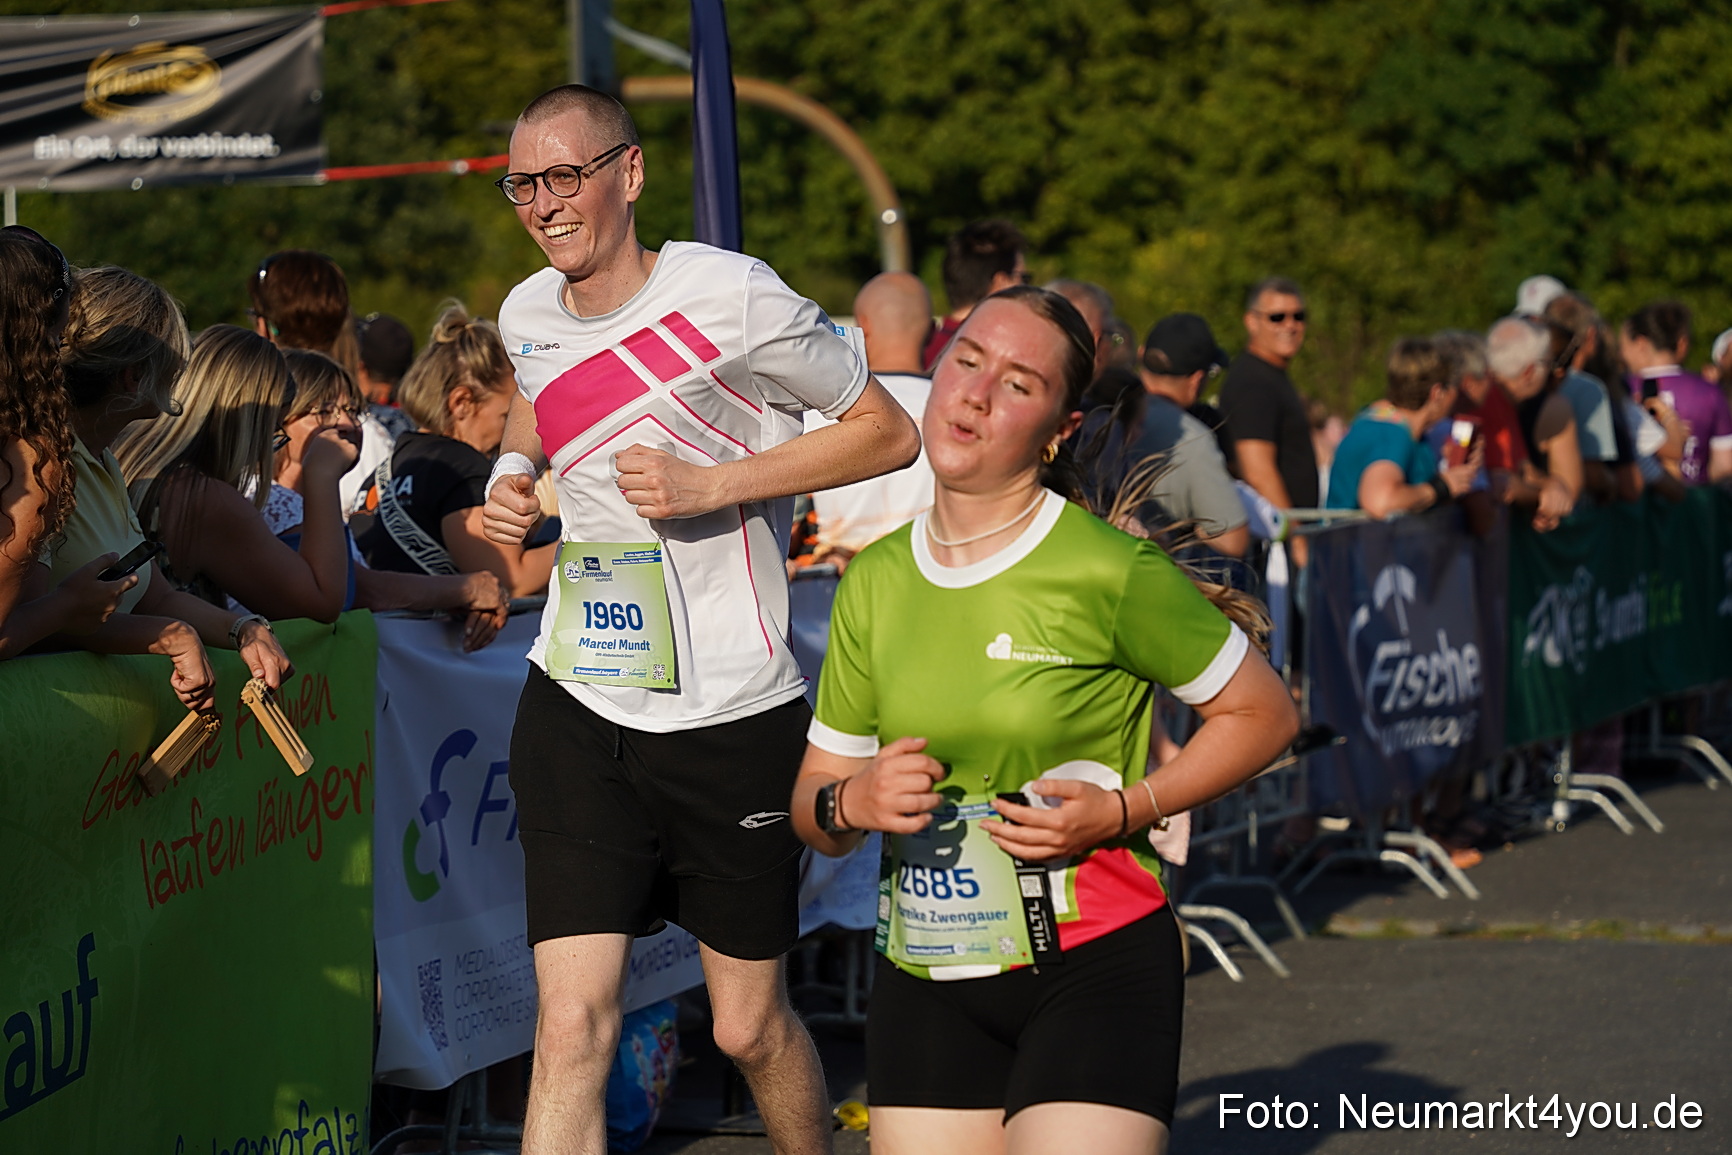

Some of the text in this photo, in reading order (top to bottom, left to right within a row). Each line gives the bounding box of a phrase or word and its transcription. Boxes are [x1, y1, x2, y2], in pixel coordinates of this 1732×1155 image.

[33, 134, 70, 160] Ein
[119, 133, 159, 159] der
[582, 601, 644, 631] 1960
[578, 637, 651, 651] Marcel Mundt
[140, 797, 245, 909] laufen
[900, 861, 980, 900] 2685
[928, 910, 1009, 925] Zwengauer
[1028, 900, 1048, 952] HILTL
